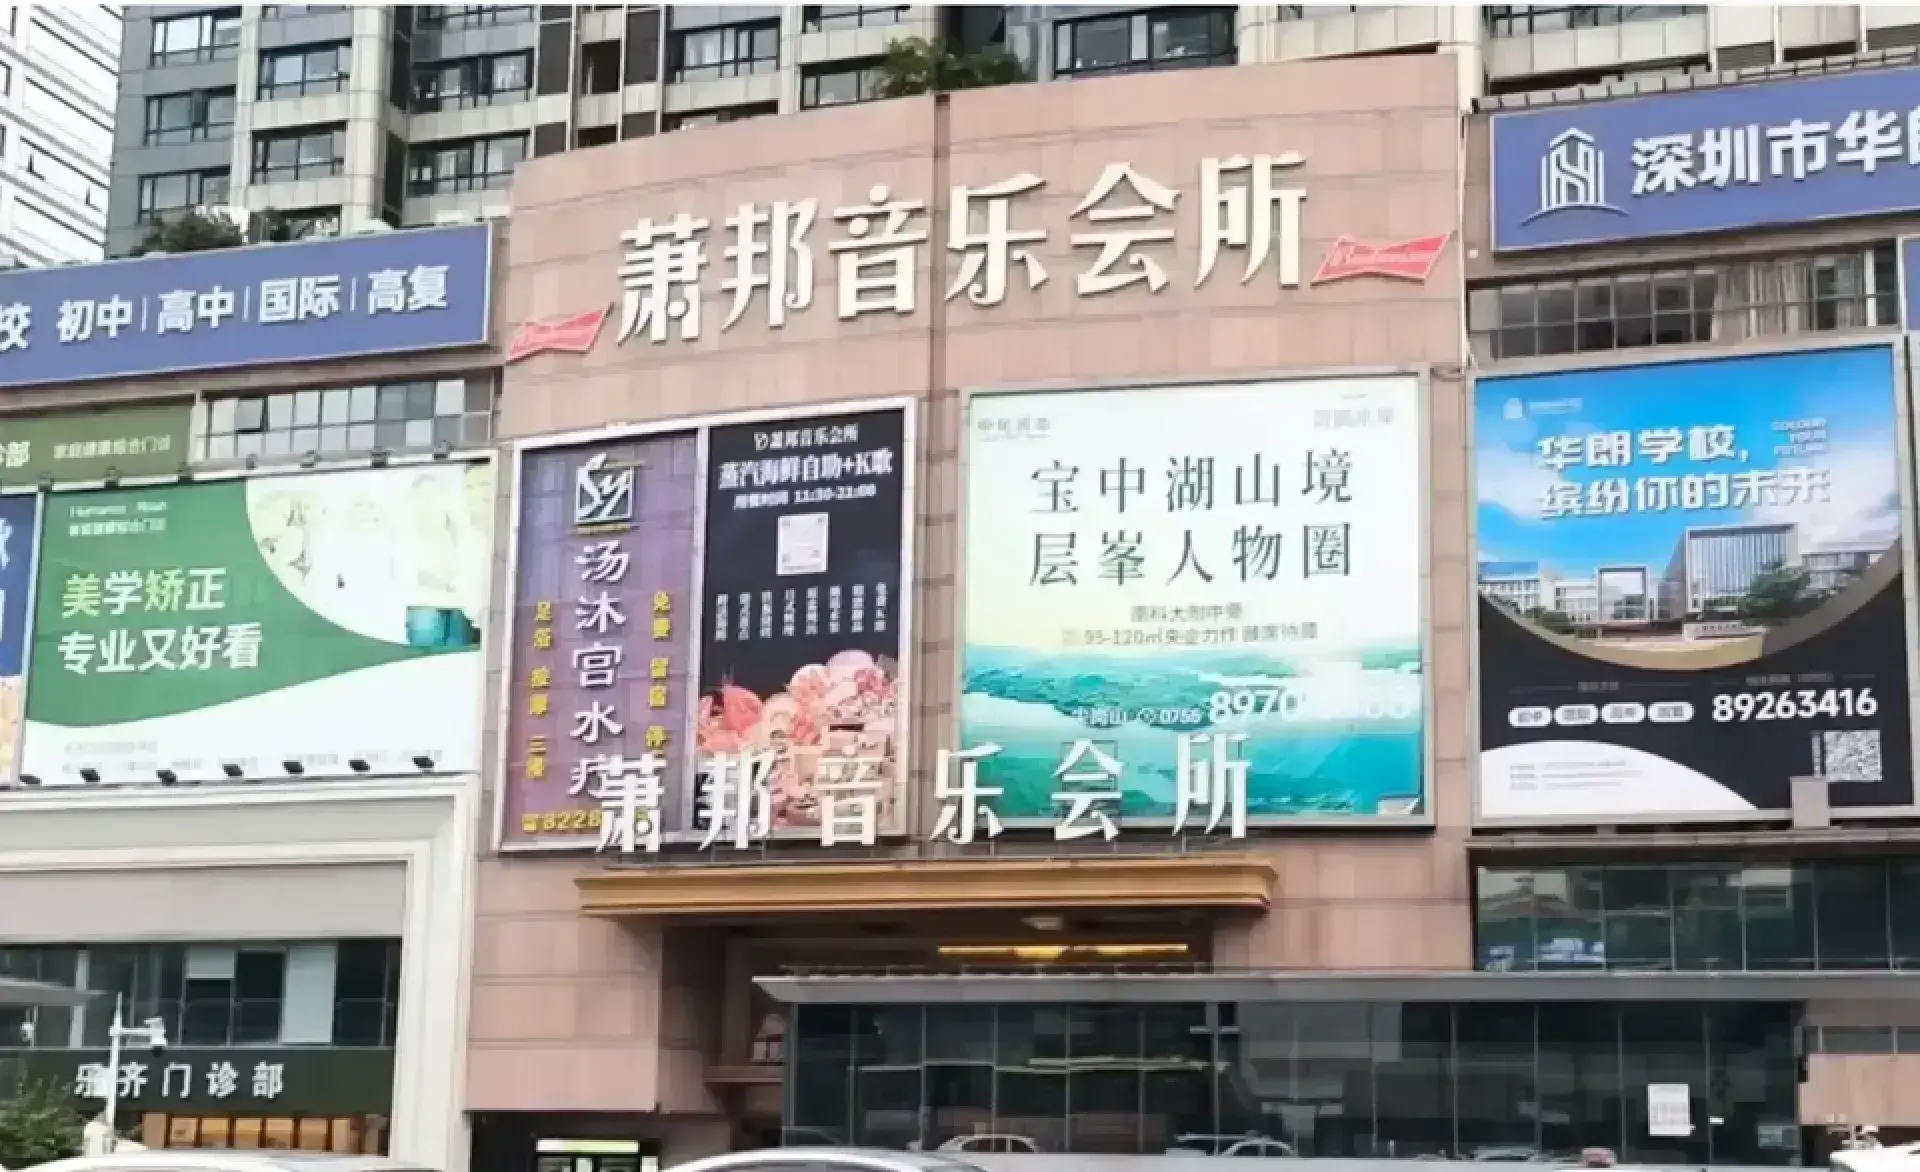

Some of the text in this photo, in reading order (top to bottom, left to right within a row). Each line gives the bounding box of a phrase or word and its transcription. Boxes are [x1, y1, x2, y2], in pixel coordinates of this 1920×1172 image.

[1631, 106, 1920, 196] 深圳市华
[617, 150, 1309, 346] 萧邦音乐会所
[0, 264, 450, 350] 校 初中 高中 国际 高复
[1030, 447, 1353, 514] 宝中湖山境
[1540, 467, 1832, 518] 缤纷你的未来
[61, 567, 227, 619] 美学矫正
[58, 621, 263, 676] 专业又好看
[1711, 687, 1878, 723] 89263416
[595, 733, 1254, 853] 萧邦音乐会所
